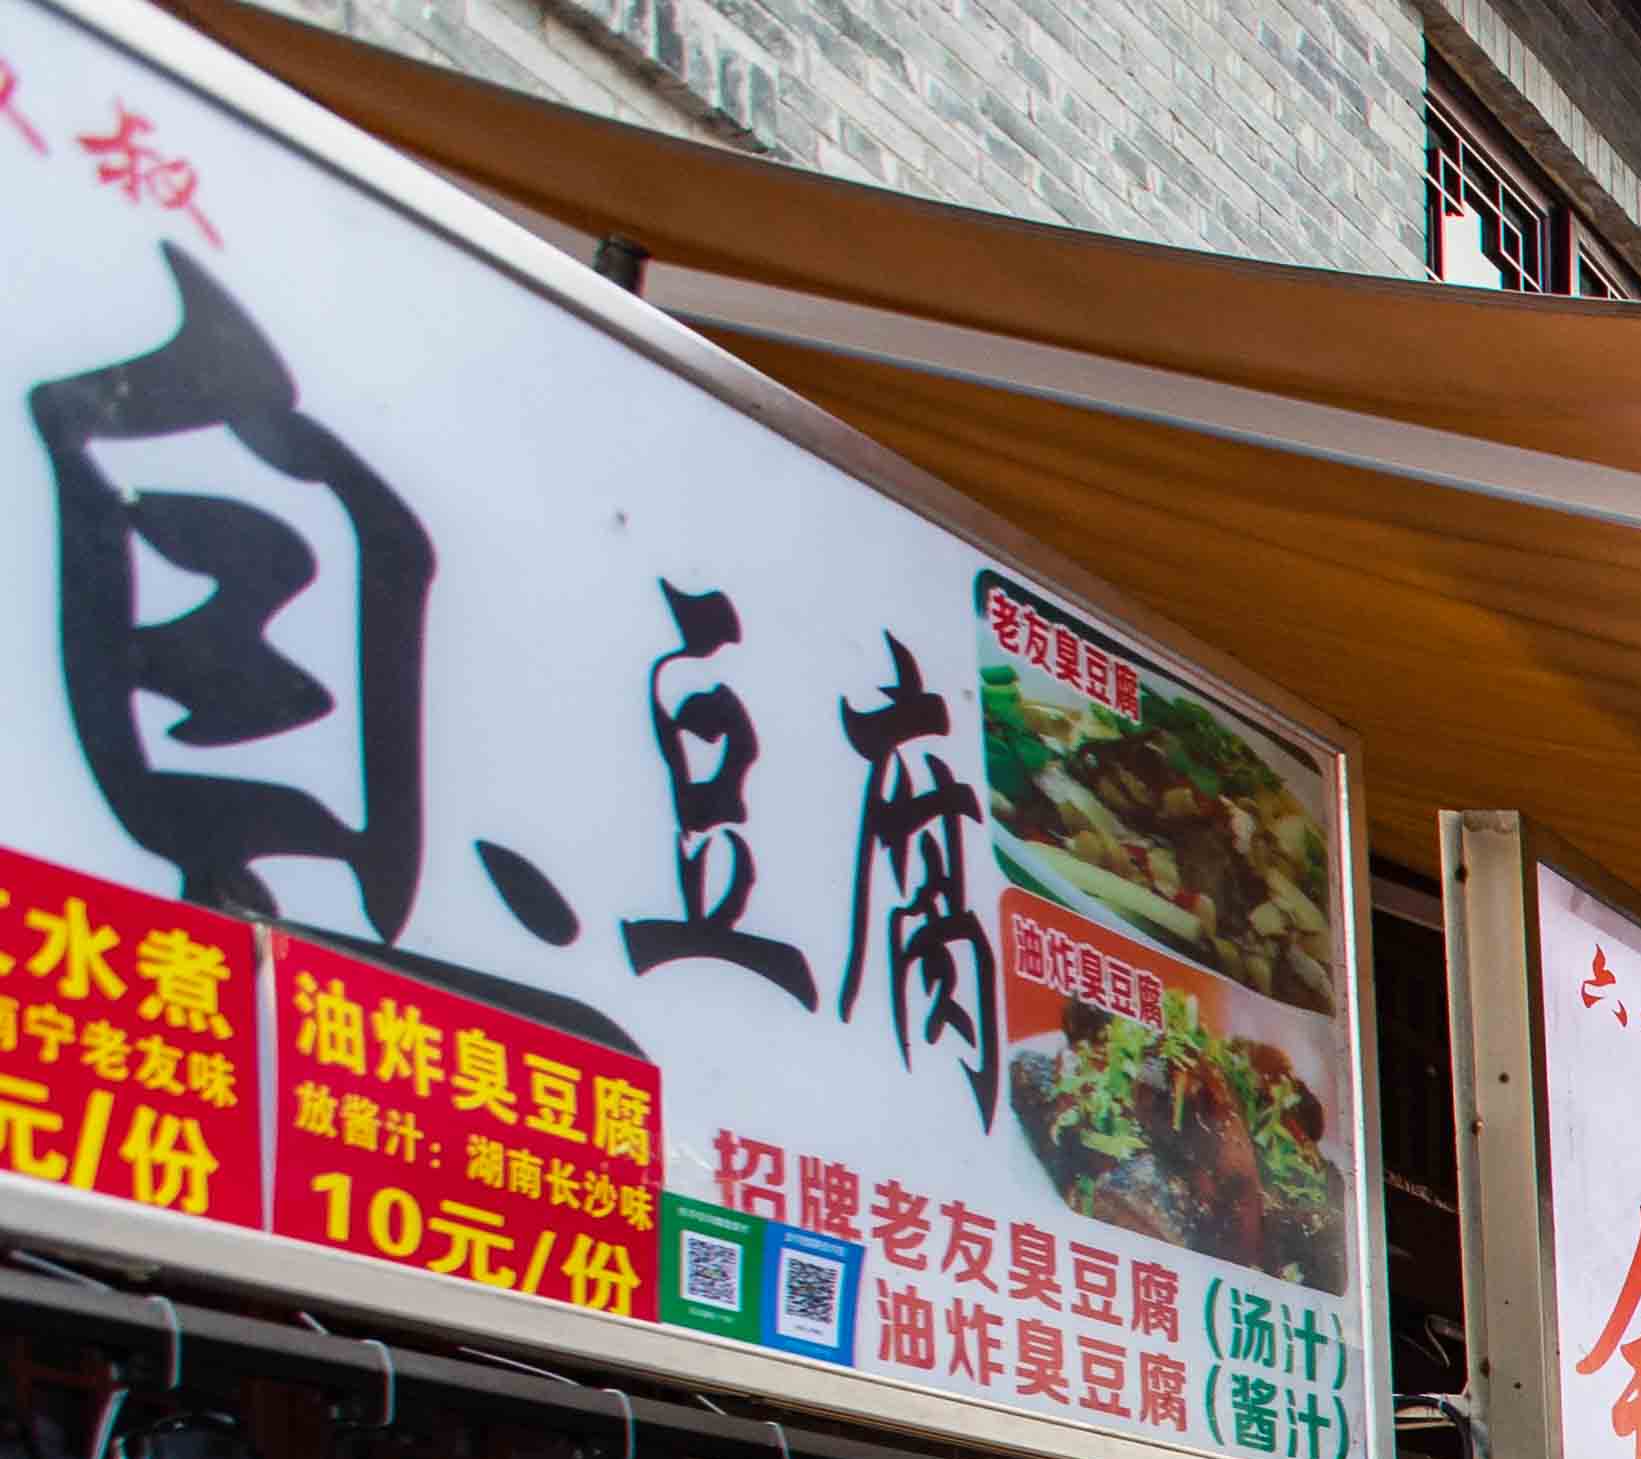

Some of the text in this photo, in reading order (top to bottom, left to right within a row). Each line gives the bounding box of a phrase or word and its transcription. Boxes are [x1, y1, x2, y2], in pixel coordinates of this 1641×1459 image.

[990, 588, 1142, 724] 老友臭豆腐
[0, 888, 233, 1040] 水煮
[1012, 912, 1166, 1034] 油炸臭豆腐
[294, 970, 654, 1167] 油炸臭豆腐
[311, 1172, 641, 1318] 10元/份
[713, 1127, 1181, 1344] 招牌老友臭豆腐
[875, 1279, 1189, 1433] 油炸臭豆腐
